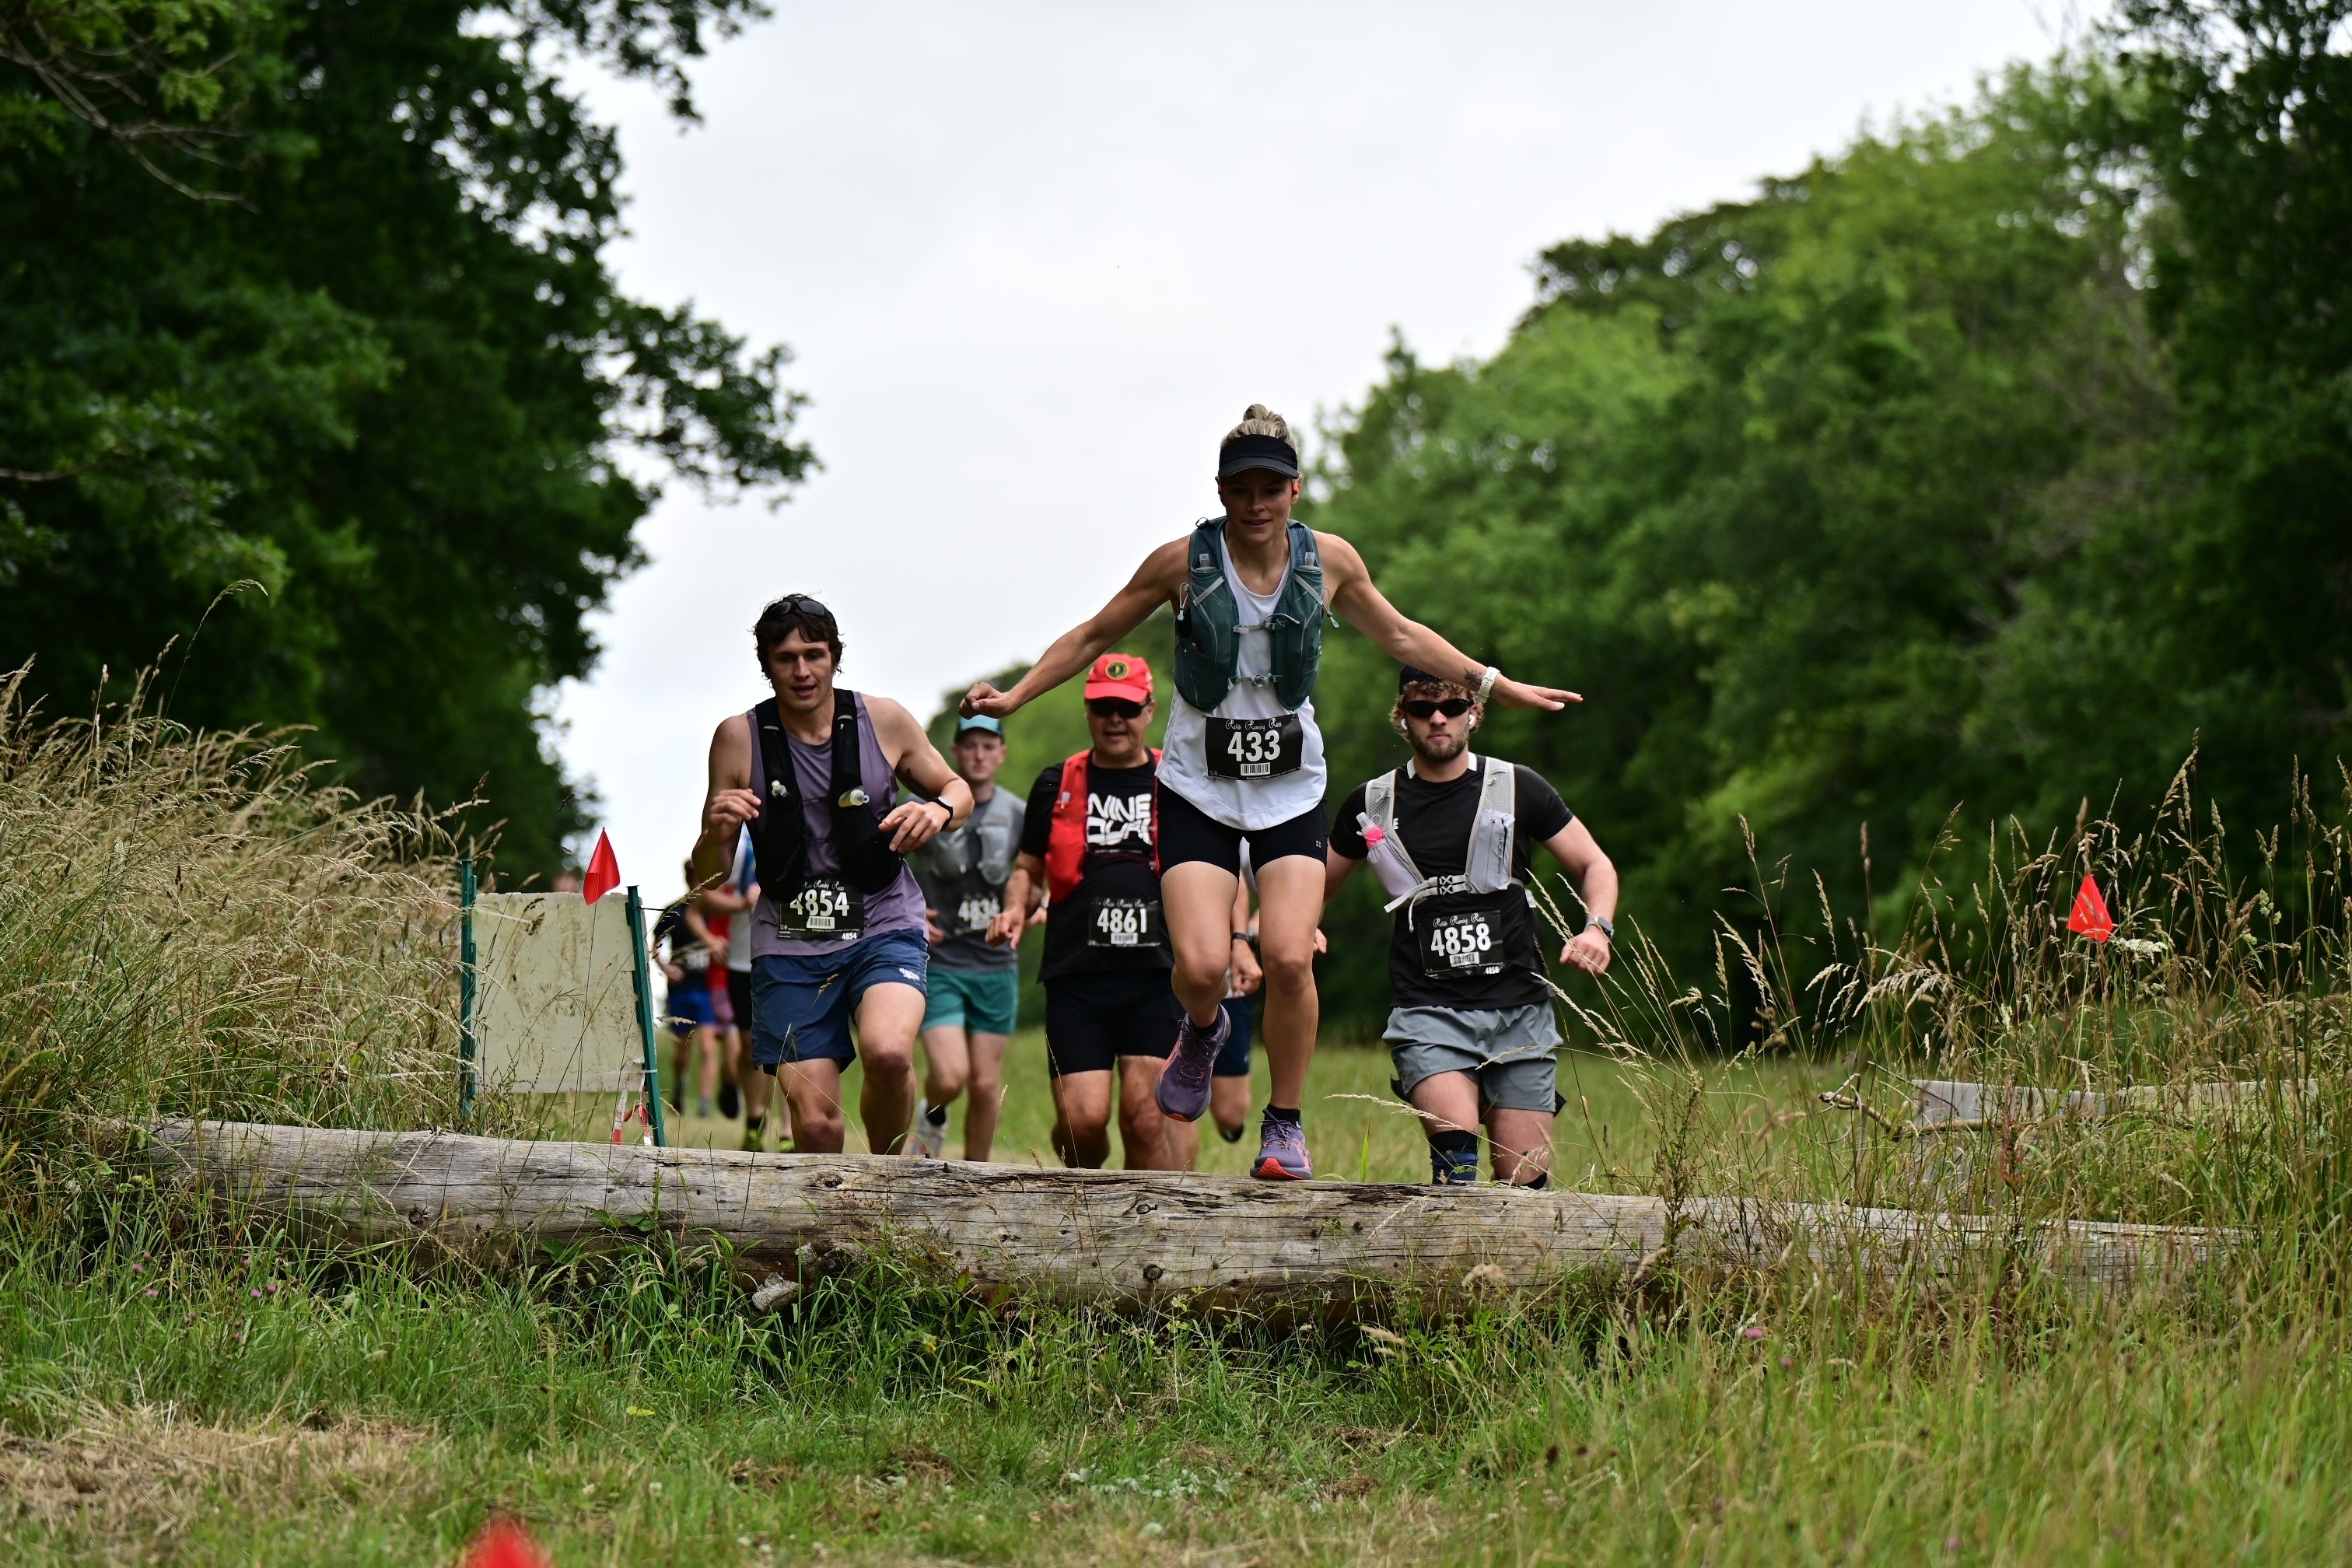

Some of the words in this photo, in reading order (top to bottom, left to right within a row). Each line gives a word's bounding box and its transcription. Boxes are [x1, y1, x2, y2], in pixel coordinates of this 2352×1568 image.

[1226, 719, 1242, 730] Relish
[1245, 720, 1265, 731] Running
[1269, 717, 1283, 729] Races
[1227, 730, 1281, 762] 433
[1087, 793, 1152, 822] NINE
[789, 889, 849, 916] 4854
[1097, 908, 1147, 933] 4861
[1450, 915, 1468, 926] Running
[1430, 922, 1492, 957] 4858
[1485, 966, 1500, 975] 4858
